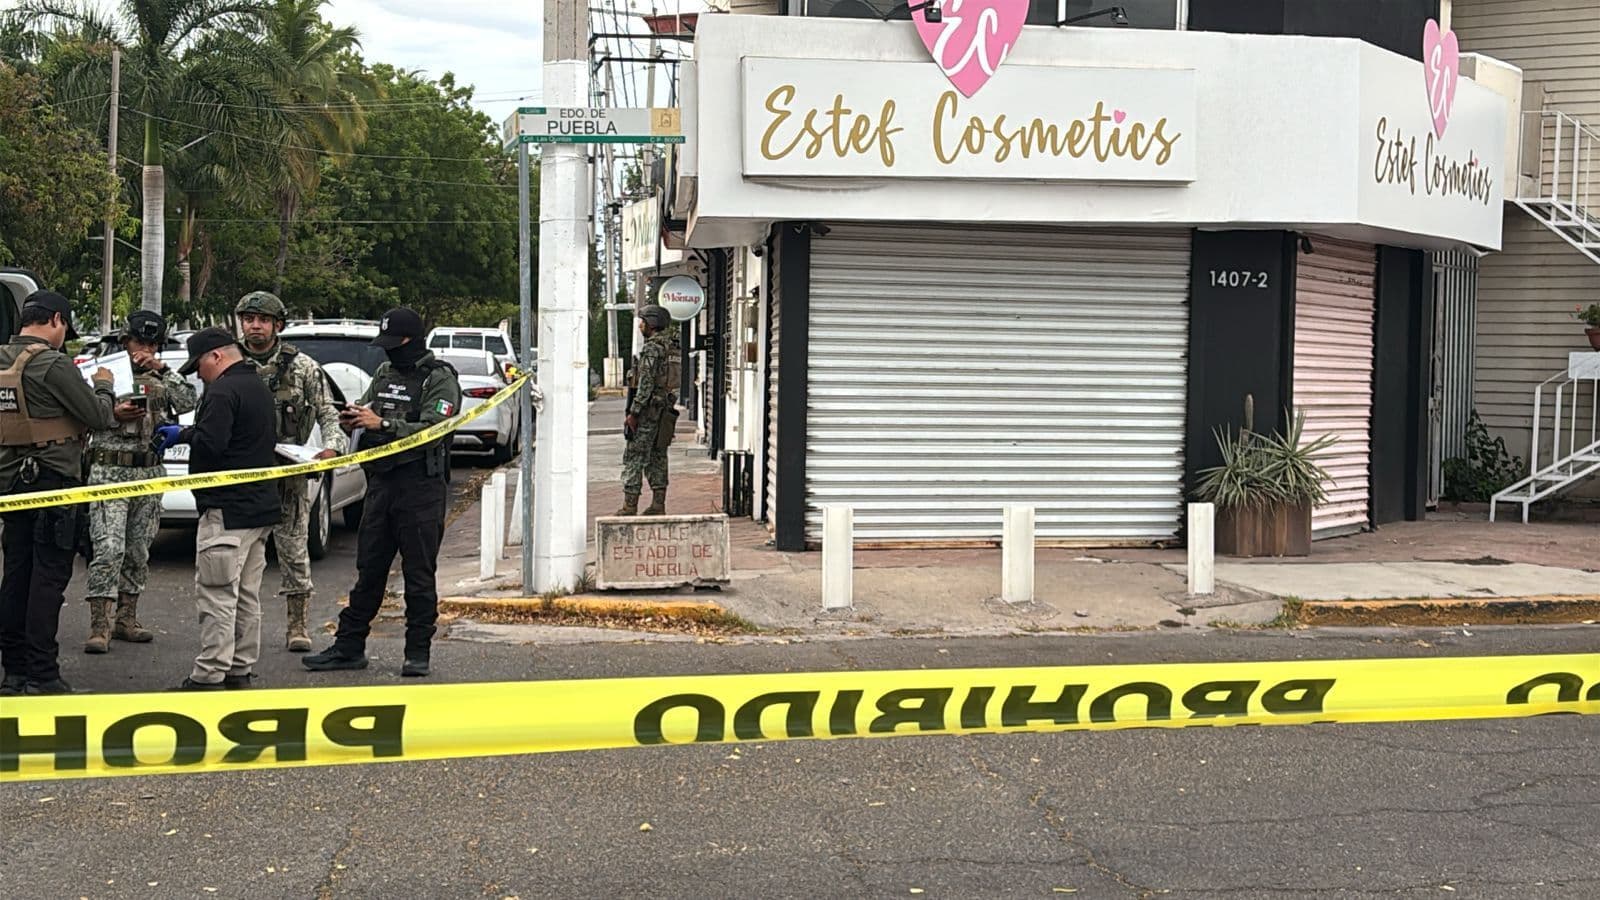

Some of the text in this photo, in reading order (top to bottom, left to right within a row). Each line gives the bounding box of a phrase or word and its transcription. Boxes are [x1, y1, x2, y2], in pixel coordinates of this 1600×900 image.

[560, 108, 607, 119] EDO. DE
[547, 121, 618, 135] PUEBLA
[760, 84, 1182, 168] Estef Cosmetics
[1375, 117, 1492, 205] Estef Cosmetics
[1208, 269, 1269, 289] 1407-2
[636, 526, 689, 542] CALLE
[613, 544, 713, 560] ESTADO DE
[635, 562, 699, 577] PUEBLA
